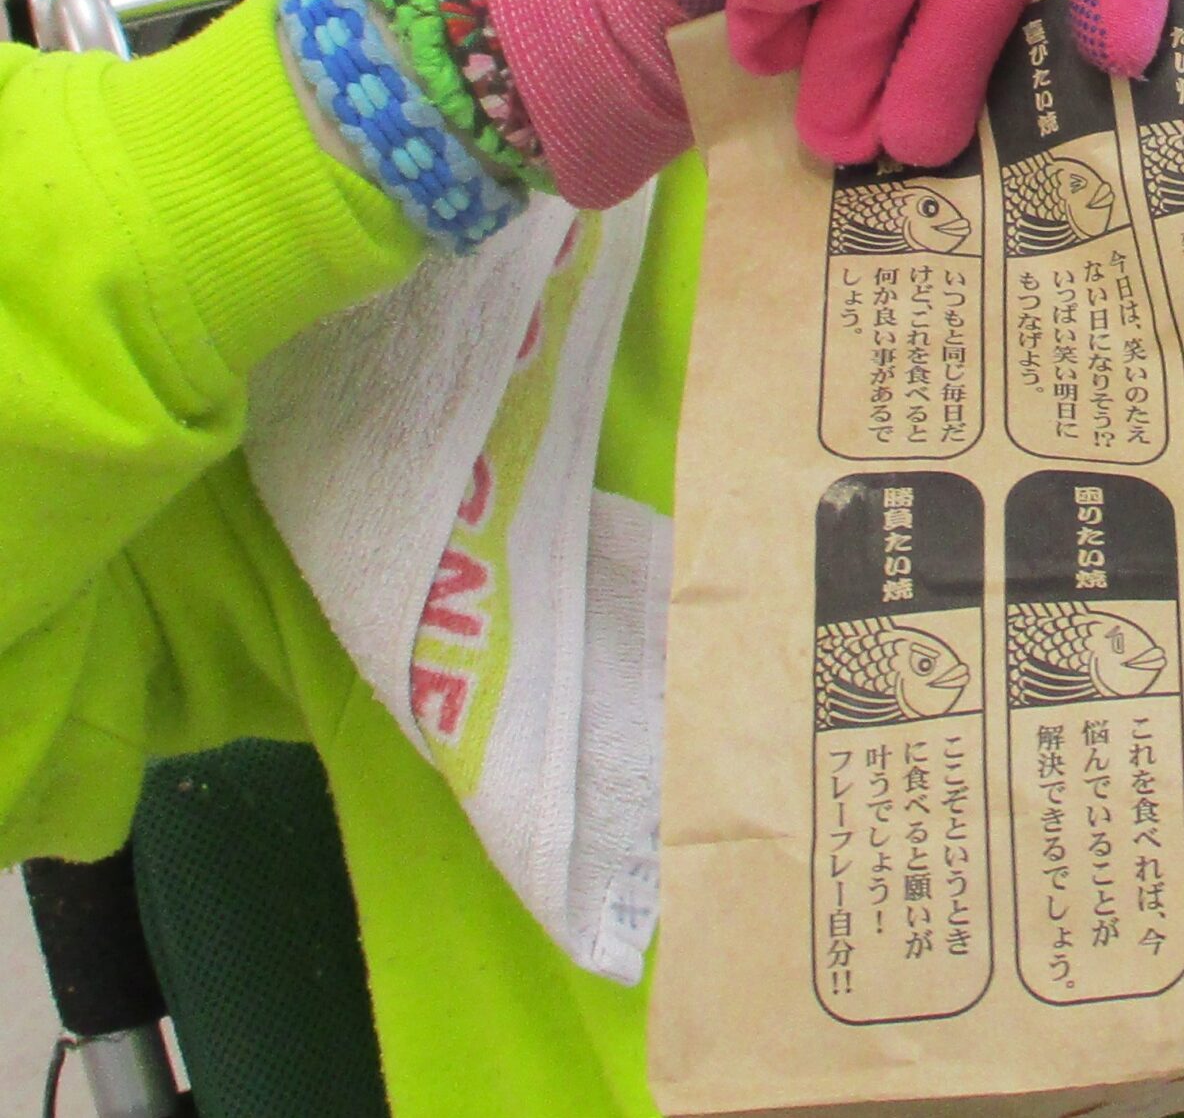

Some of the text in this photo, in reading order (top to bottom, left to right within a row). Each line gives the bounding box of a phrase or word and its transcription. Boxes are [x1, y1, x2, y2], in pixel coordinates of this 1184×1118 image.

[1021, 19, 1059, 138] 喜びたい焼
[840, 268, 864, 335] しょう。
[868, 267, 900, 444] 何か良い事があるで
[905, 266, 934, 444] けど、これを食べると
[941, 269, 967, 444] いつもと同じ毎日だ
[1017, 272, 1044, 395] もつなげよう。
[1052, 270, 1080, 440] いっぱい笑い明日に
[1109, 250, 1152, 446] 今日は、笑いのたえ
[882, 486, 914, 602] 勝負たい焼
[1074, 485, 1108, 590] 困りたい焼
[865, 743, 893, 935] 叶うでしょう！
[902, 740, 934, 960] に食べると願いが
[941, 735, 972, 957] ここぞというとき
[1037, 724, 1076, 990] 解決できるでしょう。
[1080, 719, 1119, 948] 悩んでいることが
[1128, 716, 1167, 956] これを食べれば、今
